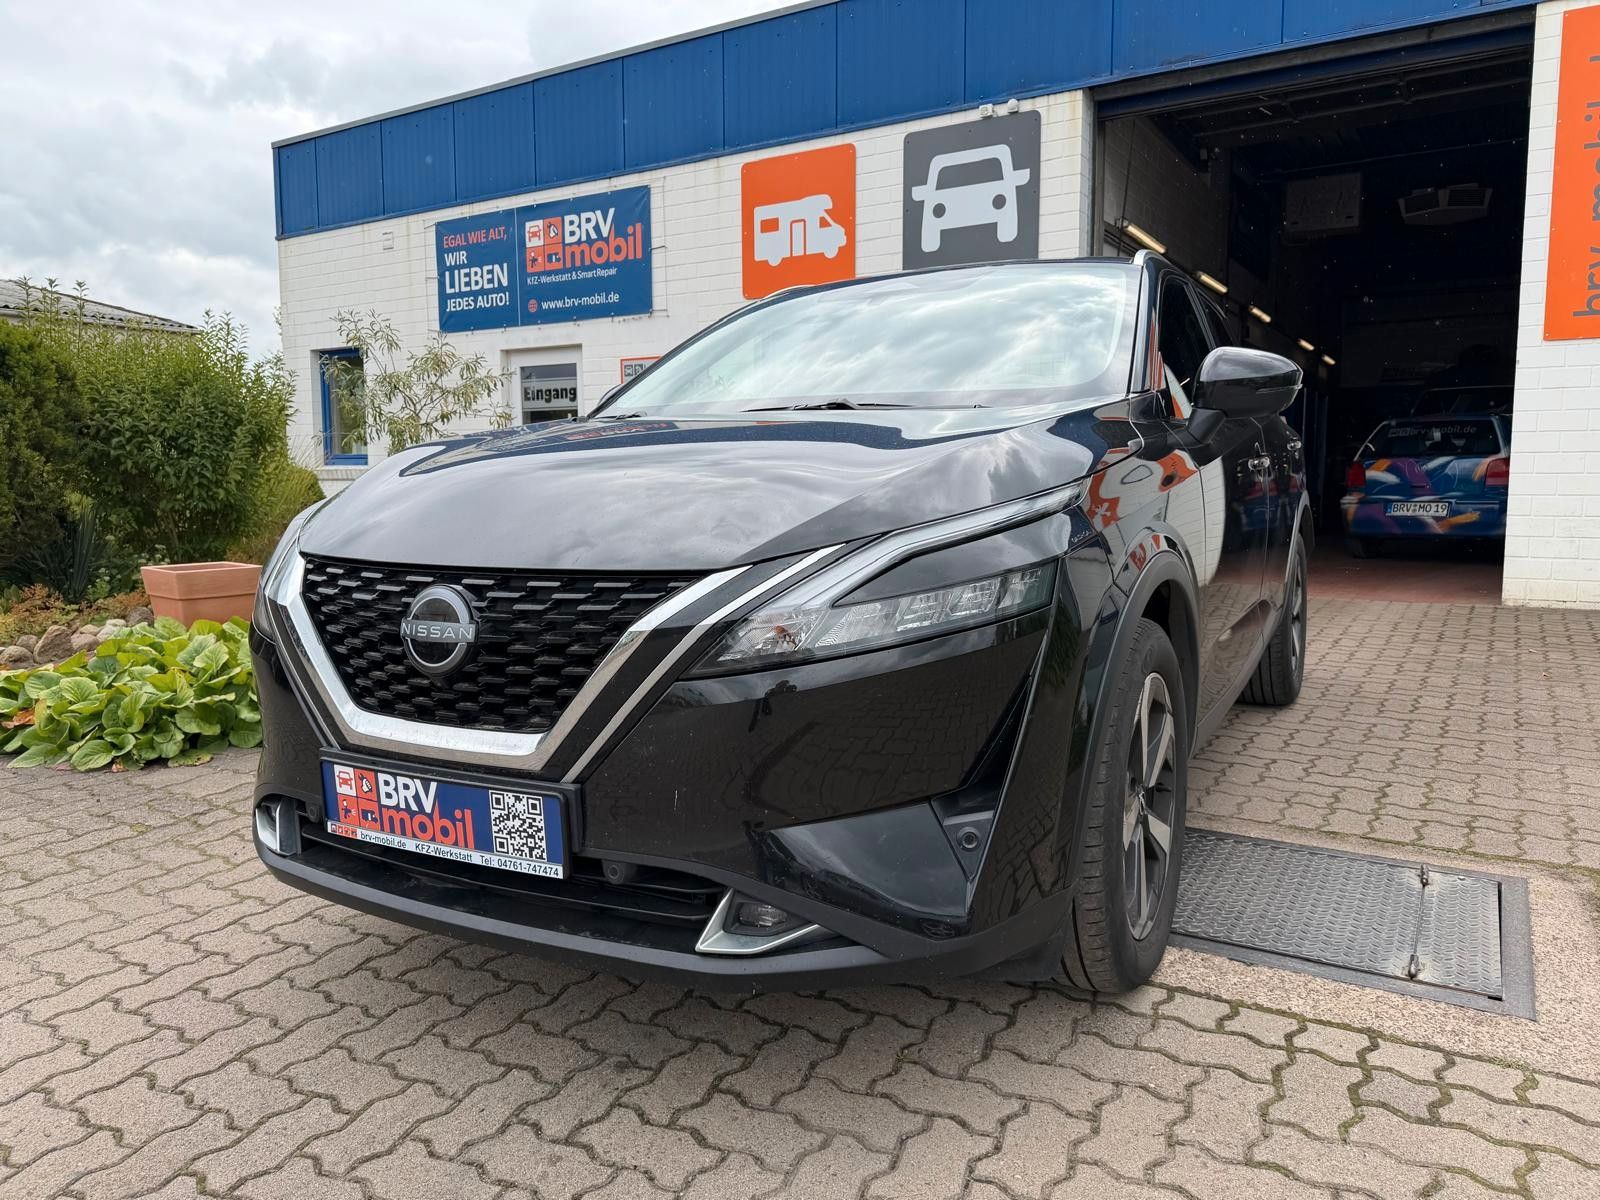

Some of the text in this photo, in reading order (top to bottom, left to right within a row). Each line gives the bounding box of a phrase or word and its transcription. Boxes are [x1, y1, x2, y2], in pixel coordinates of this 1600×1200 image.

[564, 207, 615, 244] BRV
[443, 226, 507, 248] EGAL WIE ALT,
[565, 222, 642, 268] mobil
[444, 250, 467, 267] WIR
[445, 262, 508, 294] LIEBEN
[571, 272, 577, 280] &
[577, 269, 597, 280] Smart
[596, 267, 618, 278] Repair
[446, 291, 509, 312] JEDES AUTO!
[541, 291, 620, 310] www.brv-mobil.de
[523, 386, 577, 404] Eingang
[1392, 503, 1447, 513] BRV MO 19
[401, 622, 473, 639] NISSAN
[377, 772, 437, 813] BRV
[382, 799, 475, 850] mobil
[360, 831, 560, 877] brv-mobil.de KFZ-Werkstatt Tel: 04761-747474
